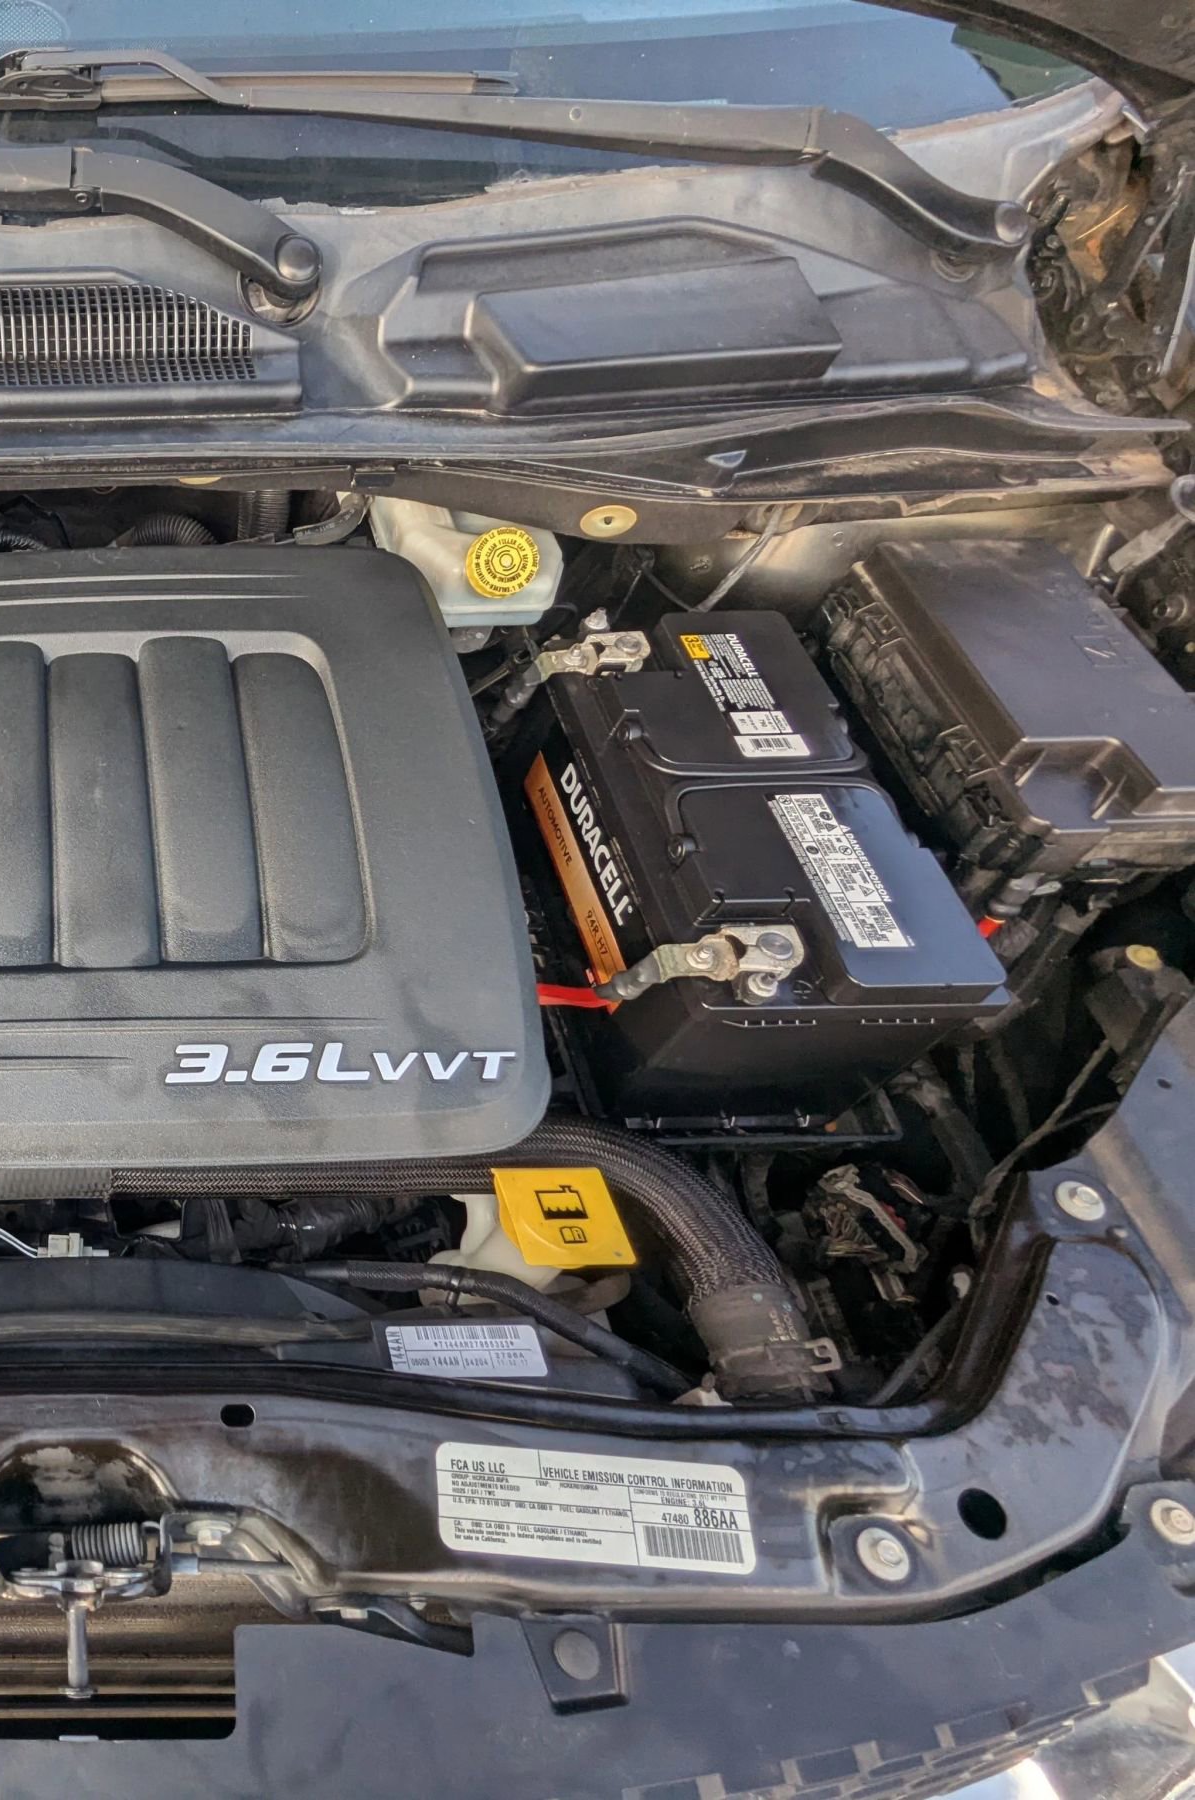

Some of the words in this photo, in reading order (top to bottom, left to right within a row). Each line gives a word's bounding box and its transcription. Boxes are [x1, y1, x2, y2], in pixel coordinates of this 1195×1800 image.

[725, 634, 760, 678] DURACELL
[538, 787, 572, 866] AUTOMOTIVE
[165, 1042, 370, 1084] 3.6L
[373, 1051, 516, 1080] VVT
[450, 1458, 469, 1472] FCA
[472, 1460, 485, 1472] US
[488, 1462, 506, 1474] LLC
[543, 1466, 579, 1480] VEHICLE
[583, 1470, 624, 1484] EMISSION
[628, 1474, 668, 1488] CONTROL
[672, 1478, 733, 1493] INFORMATION
[660, 1496, 690, 1507] ENGINE:
[661, 1512, 689, 1524] 47480
[694, 1508, 739, 1529] 886AA
